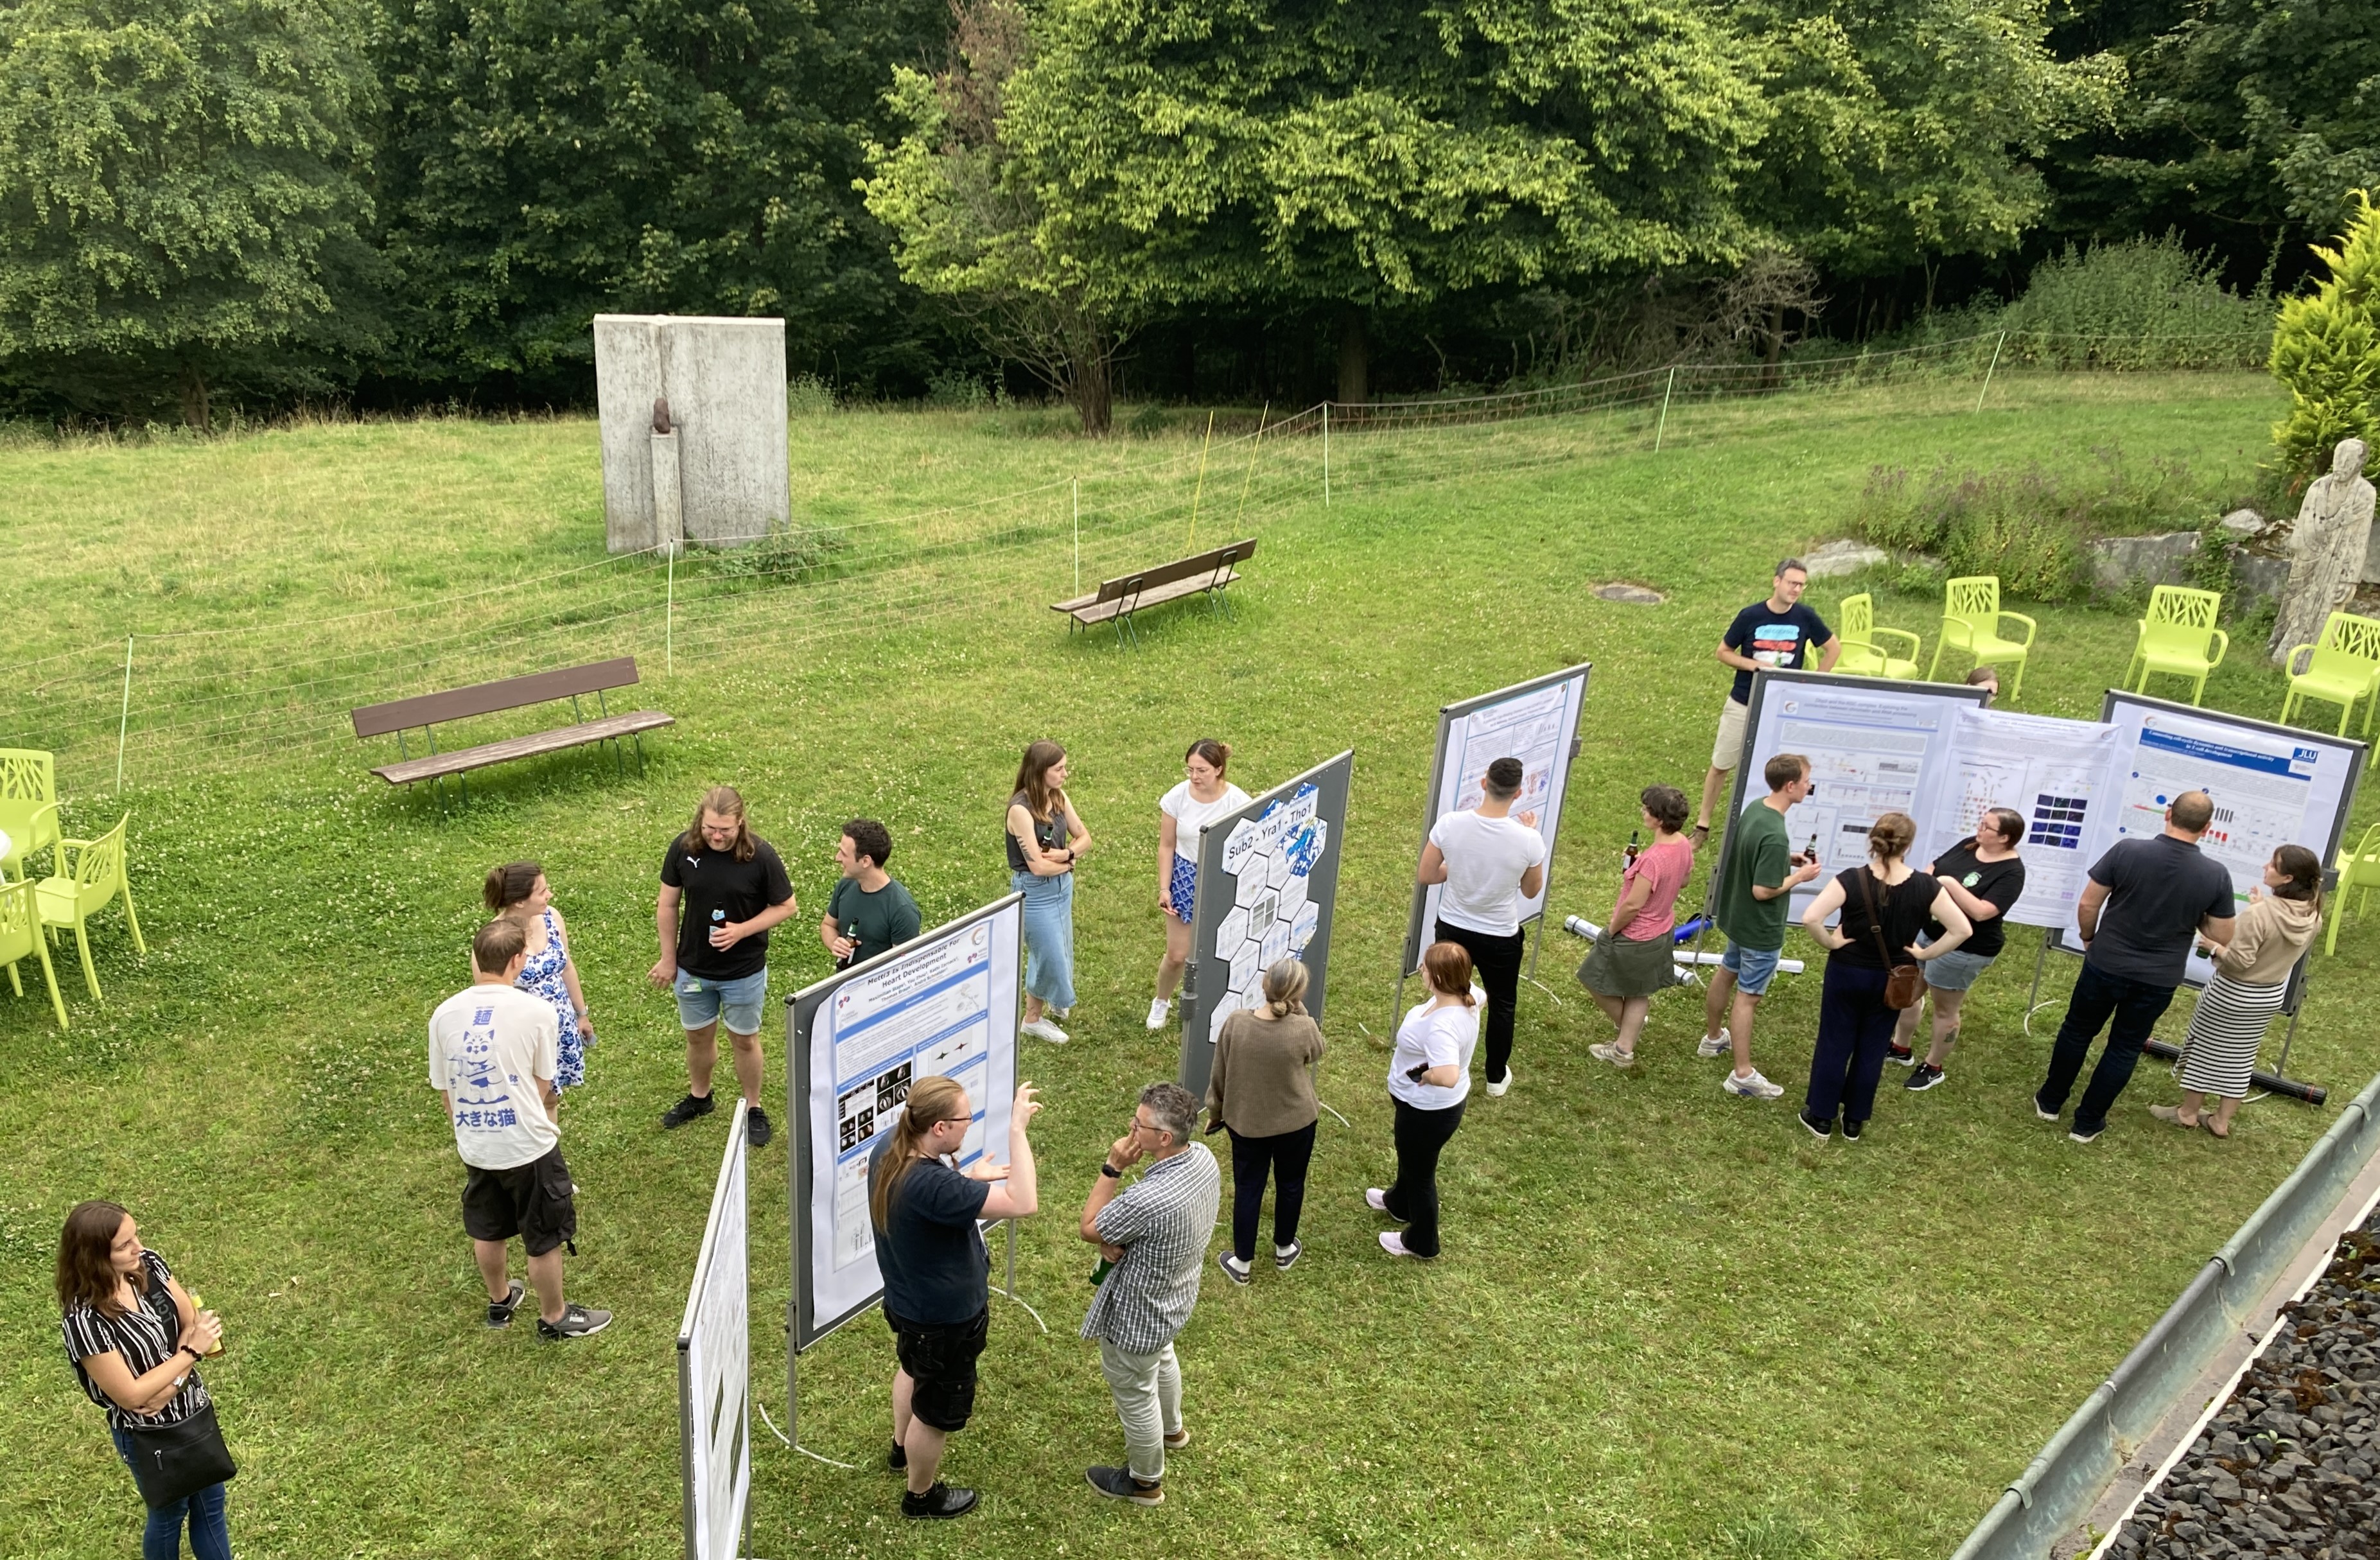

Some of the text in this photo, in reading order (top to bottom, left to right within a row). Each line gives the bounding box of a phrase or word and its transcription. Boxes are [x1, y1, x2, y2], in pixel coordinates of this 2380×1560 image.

[2298, 749, 2317, 760] JLU
[1229, 836, 1254, 859] Sub2
[1262, 819, 1282, 840] Yra1
[1290, 802, 1311, 823] Tho1
[882, 974, 901, 988] Heart
[903, 952, 947, 978] Development
[901, 944, 948, 970] Indispensable
[949, 938, 960, 947] For
[455, 1108, 516, 1128] 大きな猫
